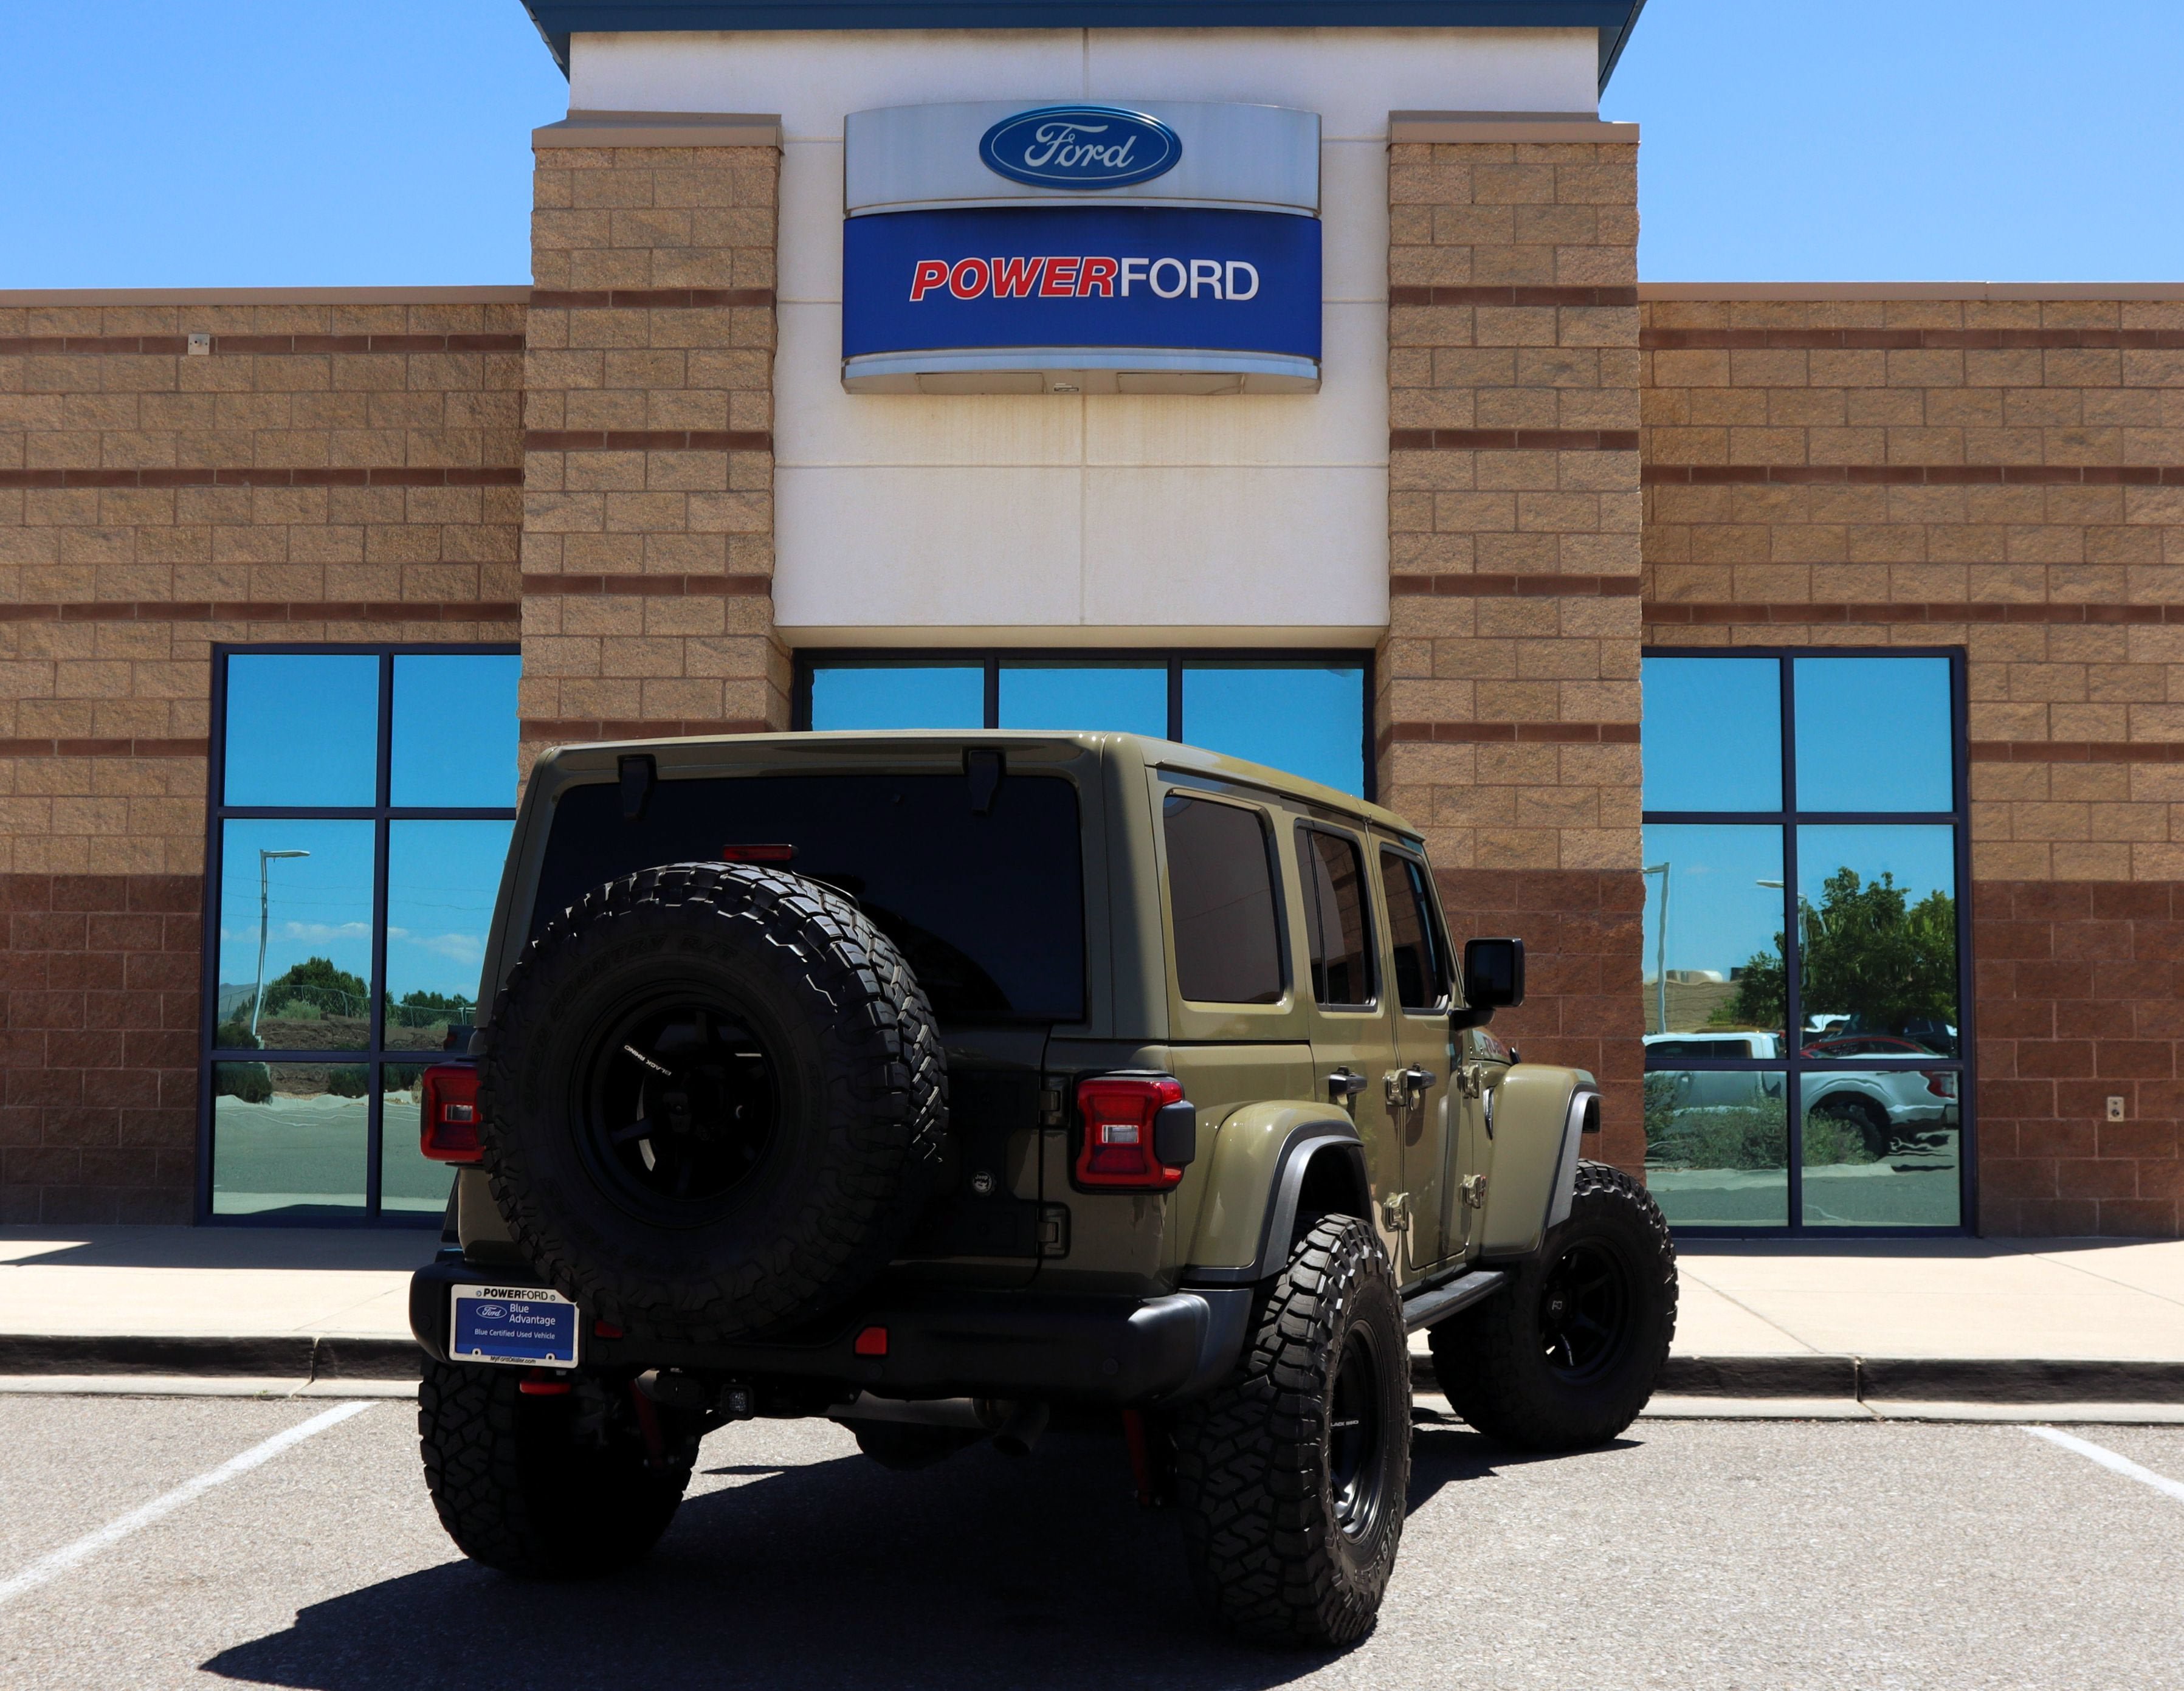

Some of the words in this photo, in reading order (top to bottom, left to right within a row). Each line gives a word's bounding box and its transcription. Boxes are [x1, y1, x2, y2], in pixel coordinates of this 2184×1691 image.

[1024, 122, 1136, 168] Ford
[909, 257, 1259, 302] POWERFORD
[624, 1045, 646, 1061] RHINO
[646, 1059, 672, 1076] BLACK
[483, 1288, 548, 1301] POWERFORD
[482, 1307, 502, 1317] Ford
[509, 1304, 529, 1314] Blue
[509, 1314, 556, 1326] Advantage
